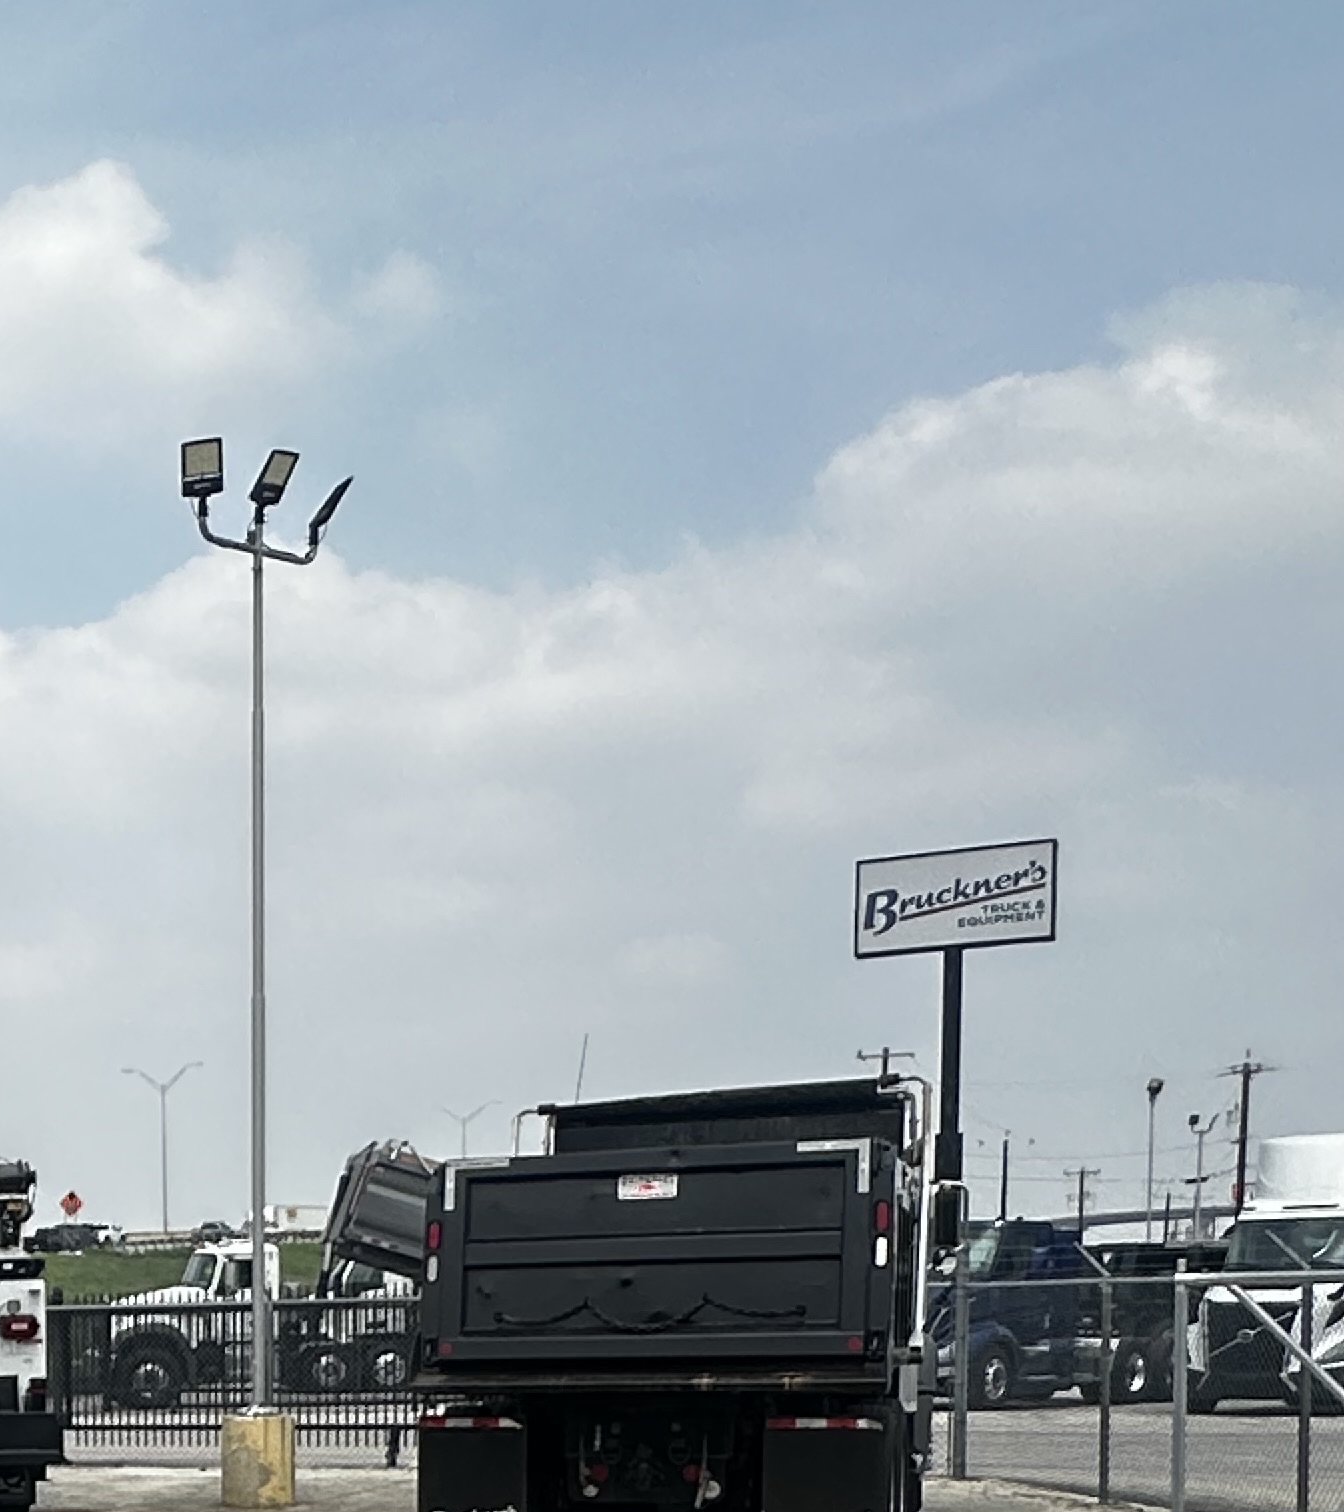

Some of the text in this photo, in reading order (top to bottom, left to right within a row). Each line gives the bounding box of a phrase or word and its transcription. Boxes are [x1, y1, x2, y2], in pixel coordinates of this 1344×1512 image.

[863, 860, 1047, 937] Bruckner's
[981, 900, 1033, 914] TRUCK
[957, 910, 1045, 928] EQUIPMENT
